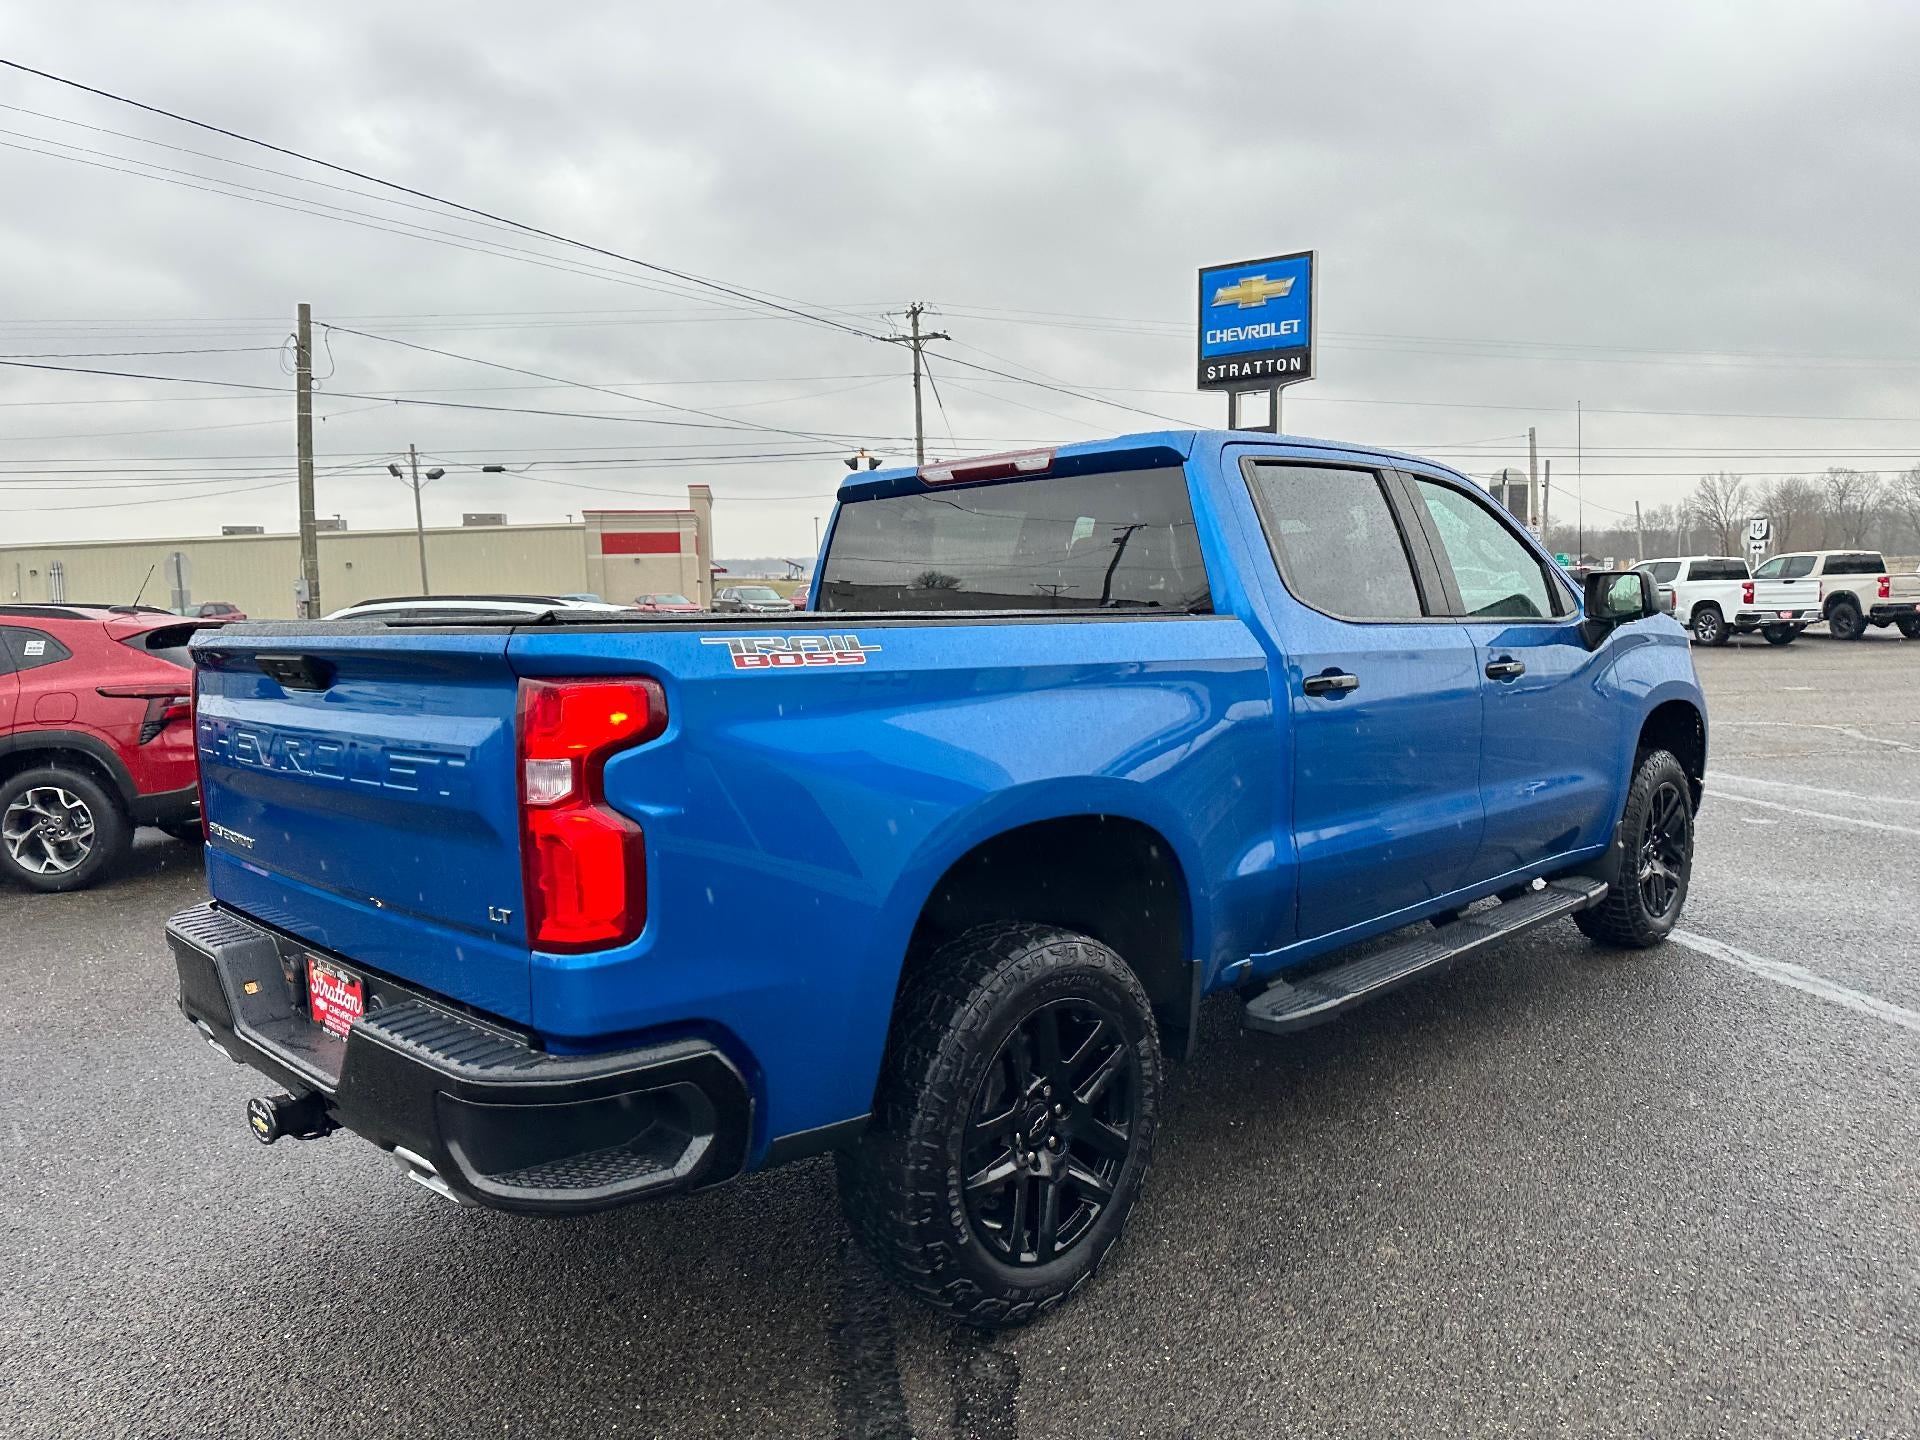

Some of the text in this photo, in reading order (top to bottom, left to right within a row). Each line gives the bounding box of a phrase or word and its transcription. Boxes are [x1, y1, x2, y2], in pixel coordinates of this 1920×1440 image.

[1206, 319, 1301, 344] CHEVROLET
[1207, 356, 1301, 380] STRATTON
[1753, 522, 1763, 535] 14
[700, 634, 881, 654] TRAIL
[732, 650, 867, 669] BOSS
[488, 906, 512, 924] LT
[312, 968, 363, 1015] Stratton
